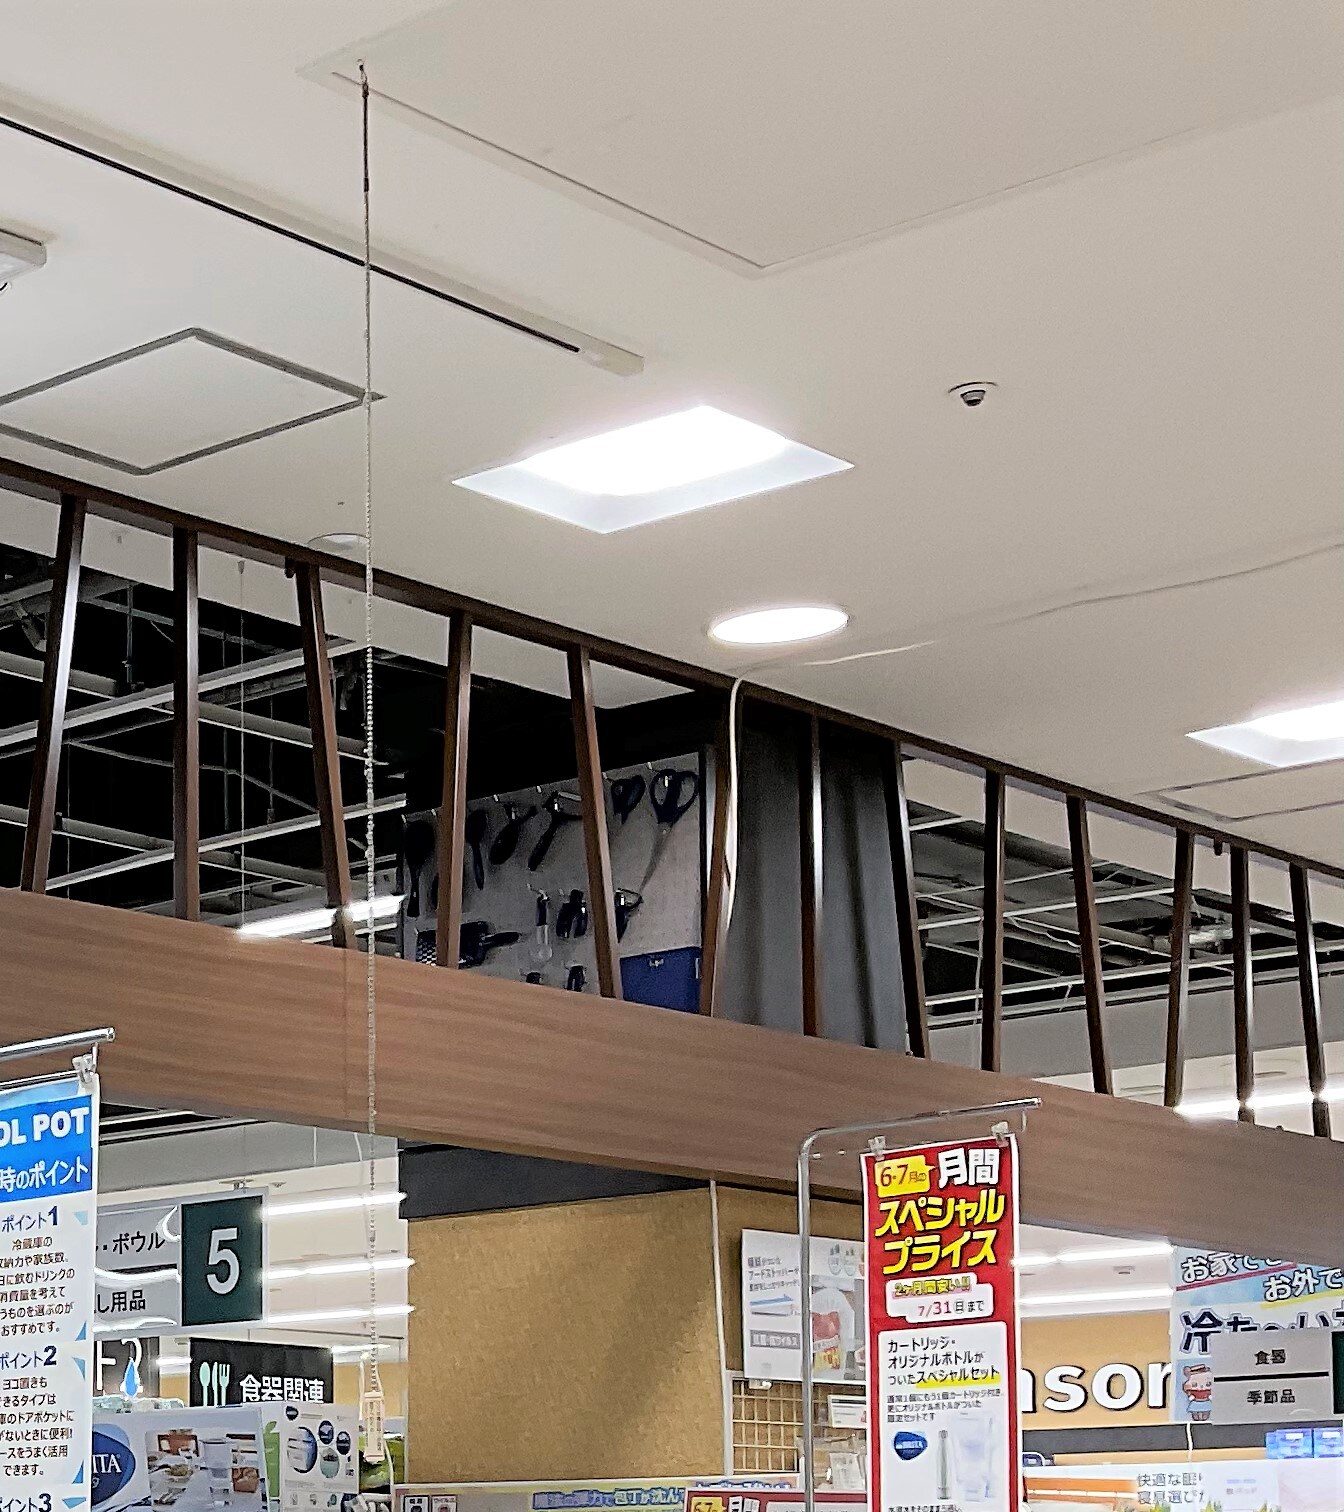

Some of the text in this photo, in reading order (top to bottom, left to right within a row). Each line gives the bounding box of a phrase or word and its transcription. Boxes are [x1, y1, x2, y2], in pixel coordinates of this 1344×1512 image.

[33, 1107, 90, 1141] POT
[938, 1148, 1000, 1188] 月間
[1, 1206, 59, 1233] ポイント1
[875, 1189, 1006, 1237] スペシャル
[96, 1231, 165, 1254] ・ボウル
[882, 1229, 998, 1275] プライス
[206, 1227, 240, 1294] 5
[93, 1290, 146, 1313] し用品
[888, 1353, 984, 1369] オリジナルボトルが
[888, 1365, 1000, 1386] ついたスペシャルセット
[240, 1374, 324, 1403] 食器関連
